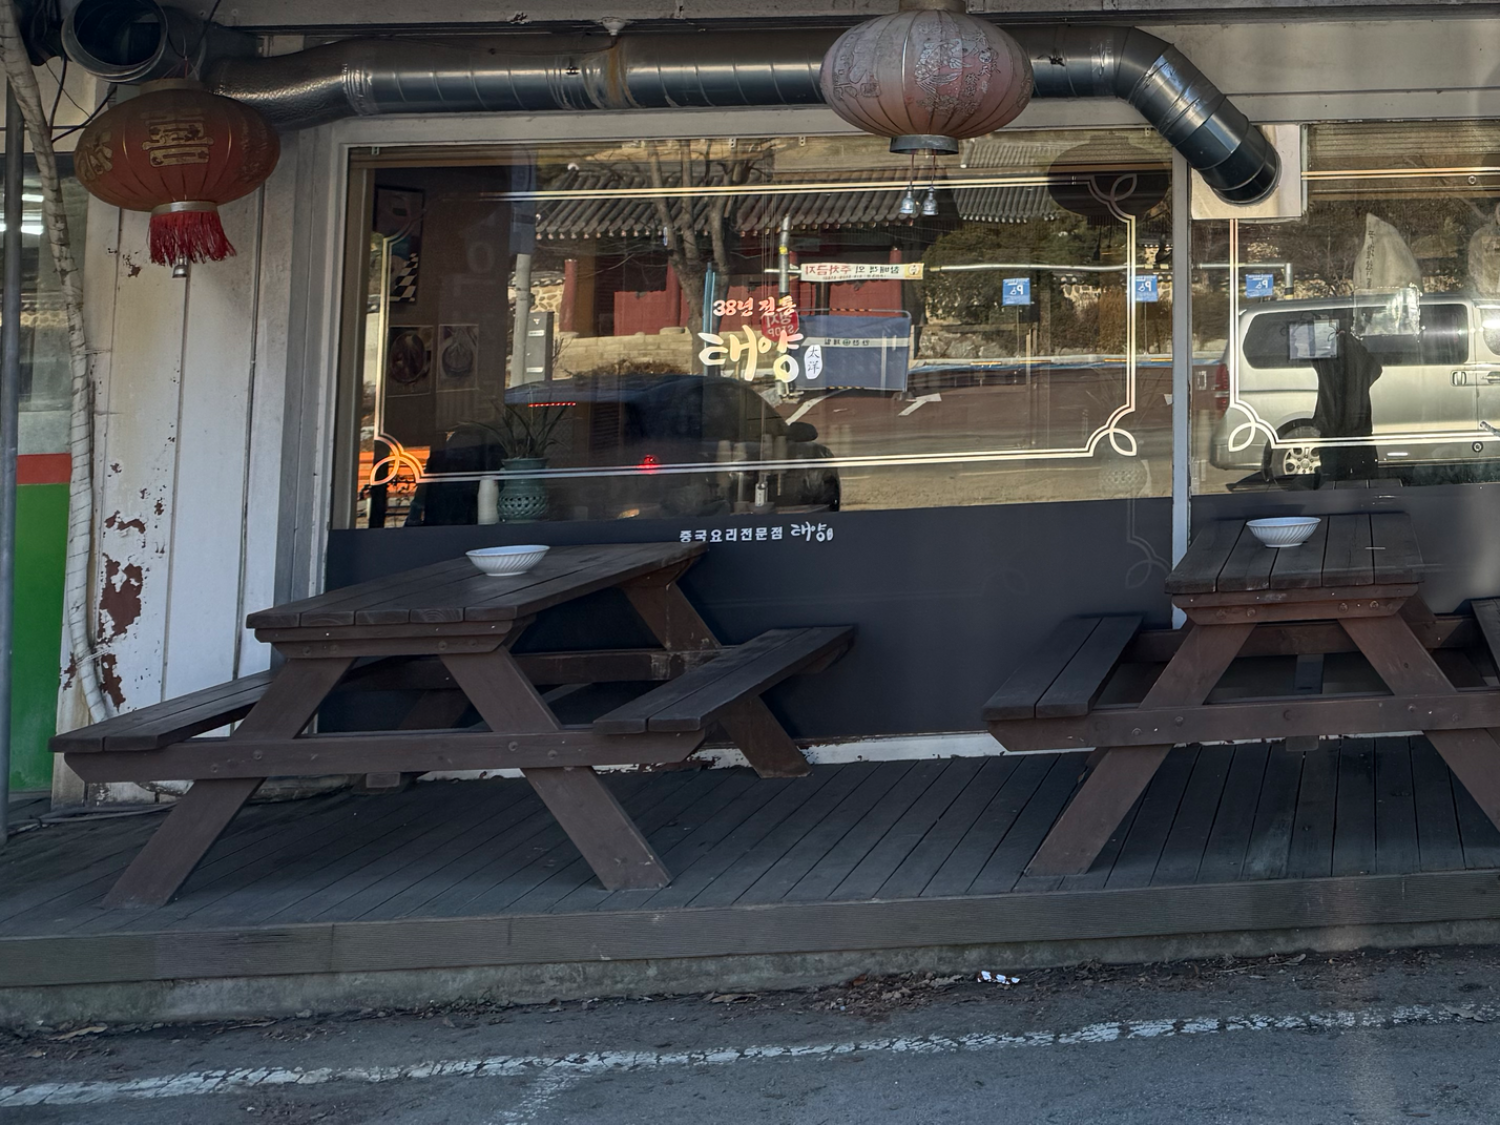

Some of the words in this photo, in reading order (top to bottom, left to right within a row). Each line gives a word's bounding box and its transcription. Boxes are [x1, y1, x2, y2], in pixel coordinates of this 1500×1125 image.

[713, 297, 754, 316] 38년
[698, 325, 804, 383] 태양
[679, 526, 783, 543] 중국요리전문점
